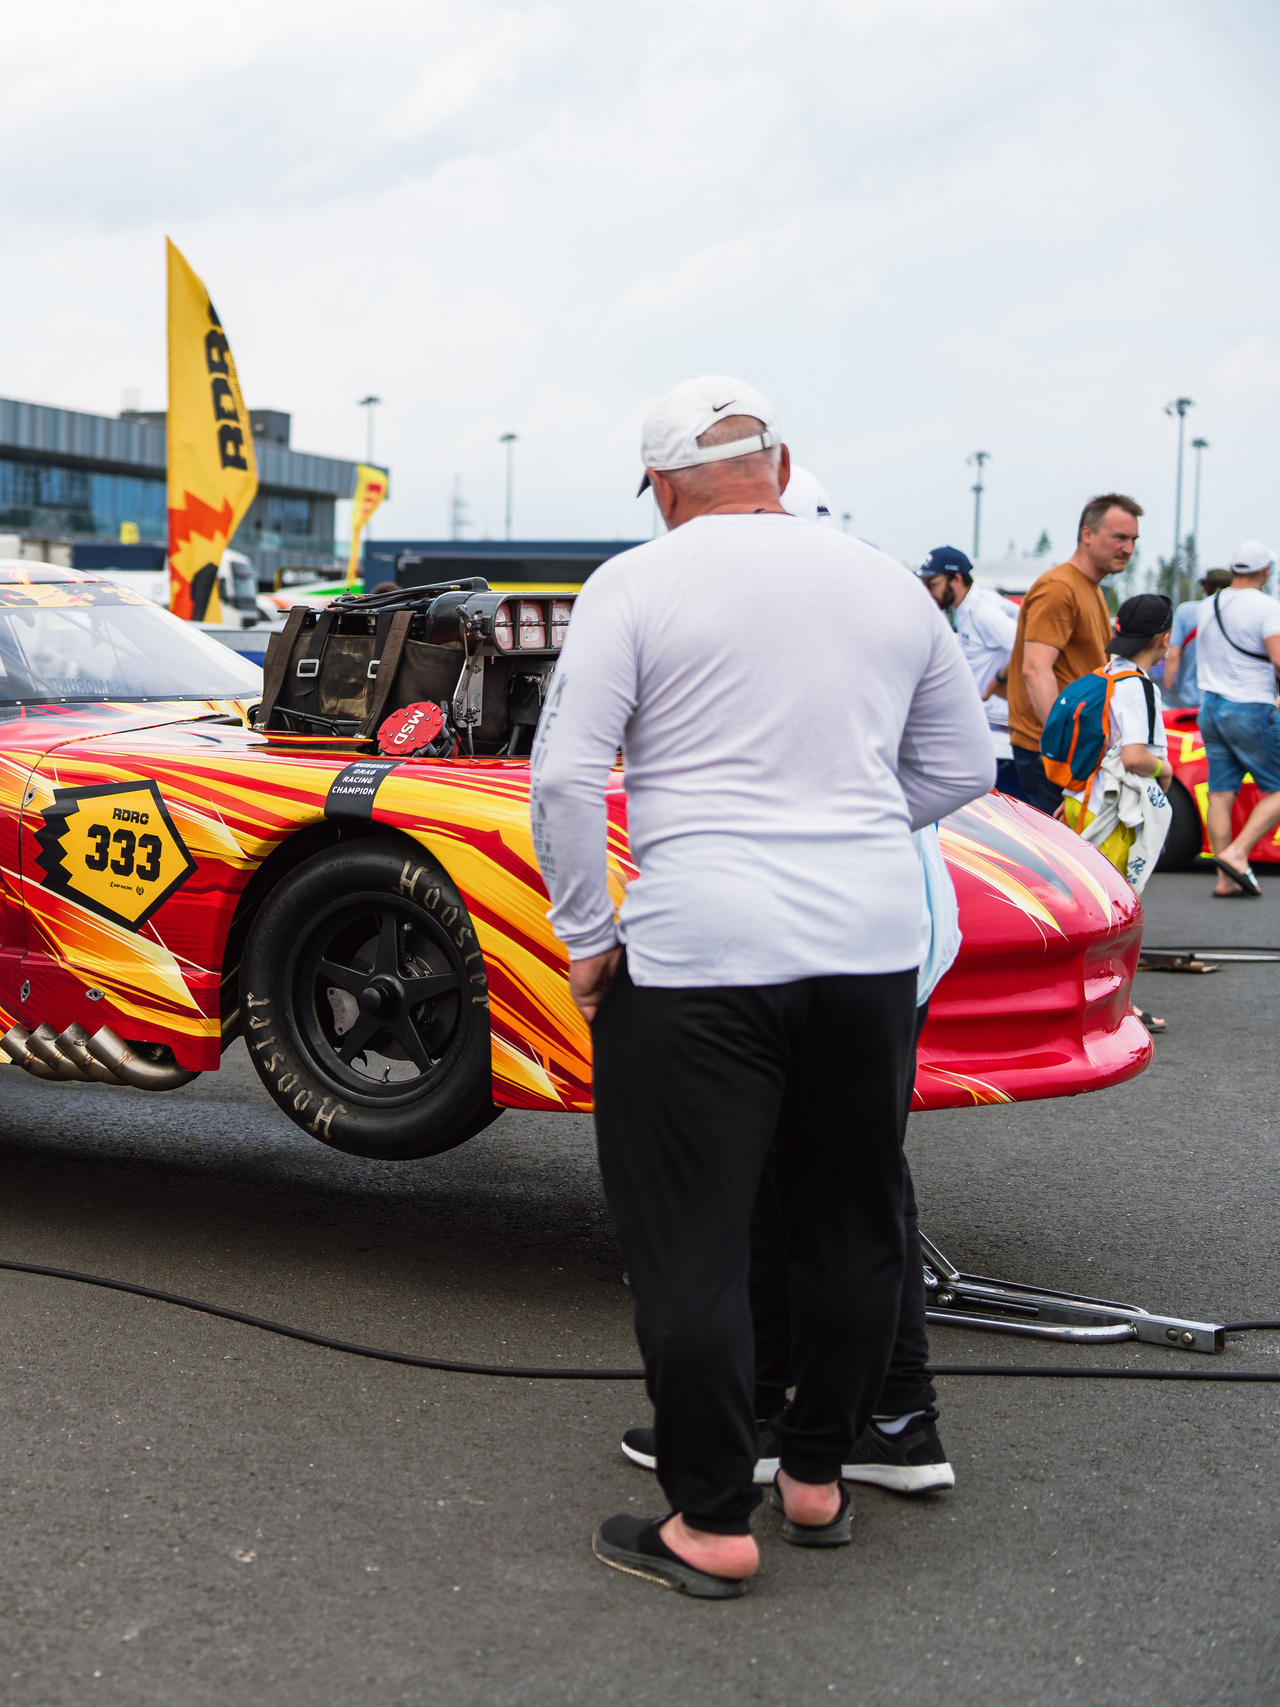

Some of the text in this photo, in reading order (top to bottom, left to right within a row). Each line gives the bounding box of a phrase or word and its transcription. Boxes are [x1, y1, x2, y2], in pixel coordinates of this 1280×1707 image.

[393, 709, 425, 746] MSD
[331, 786, 376, 795] CHAMPION
[342, 776, 374, 784] RACING
[112, 807, 150, 825] RDRC
[85, 823, 163, 882] 333
[247, 992, 348, 1139] Hoosier
